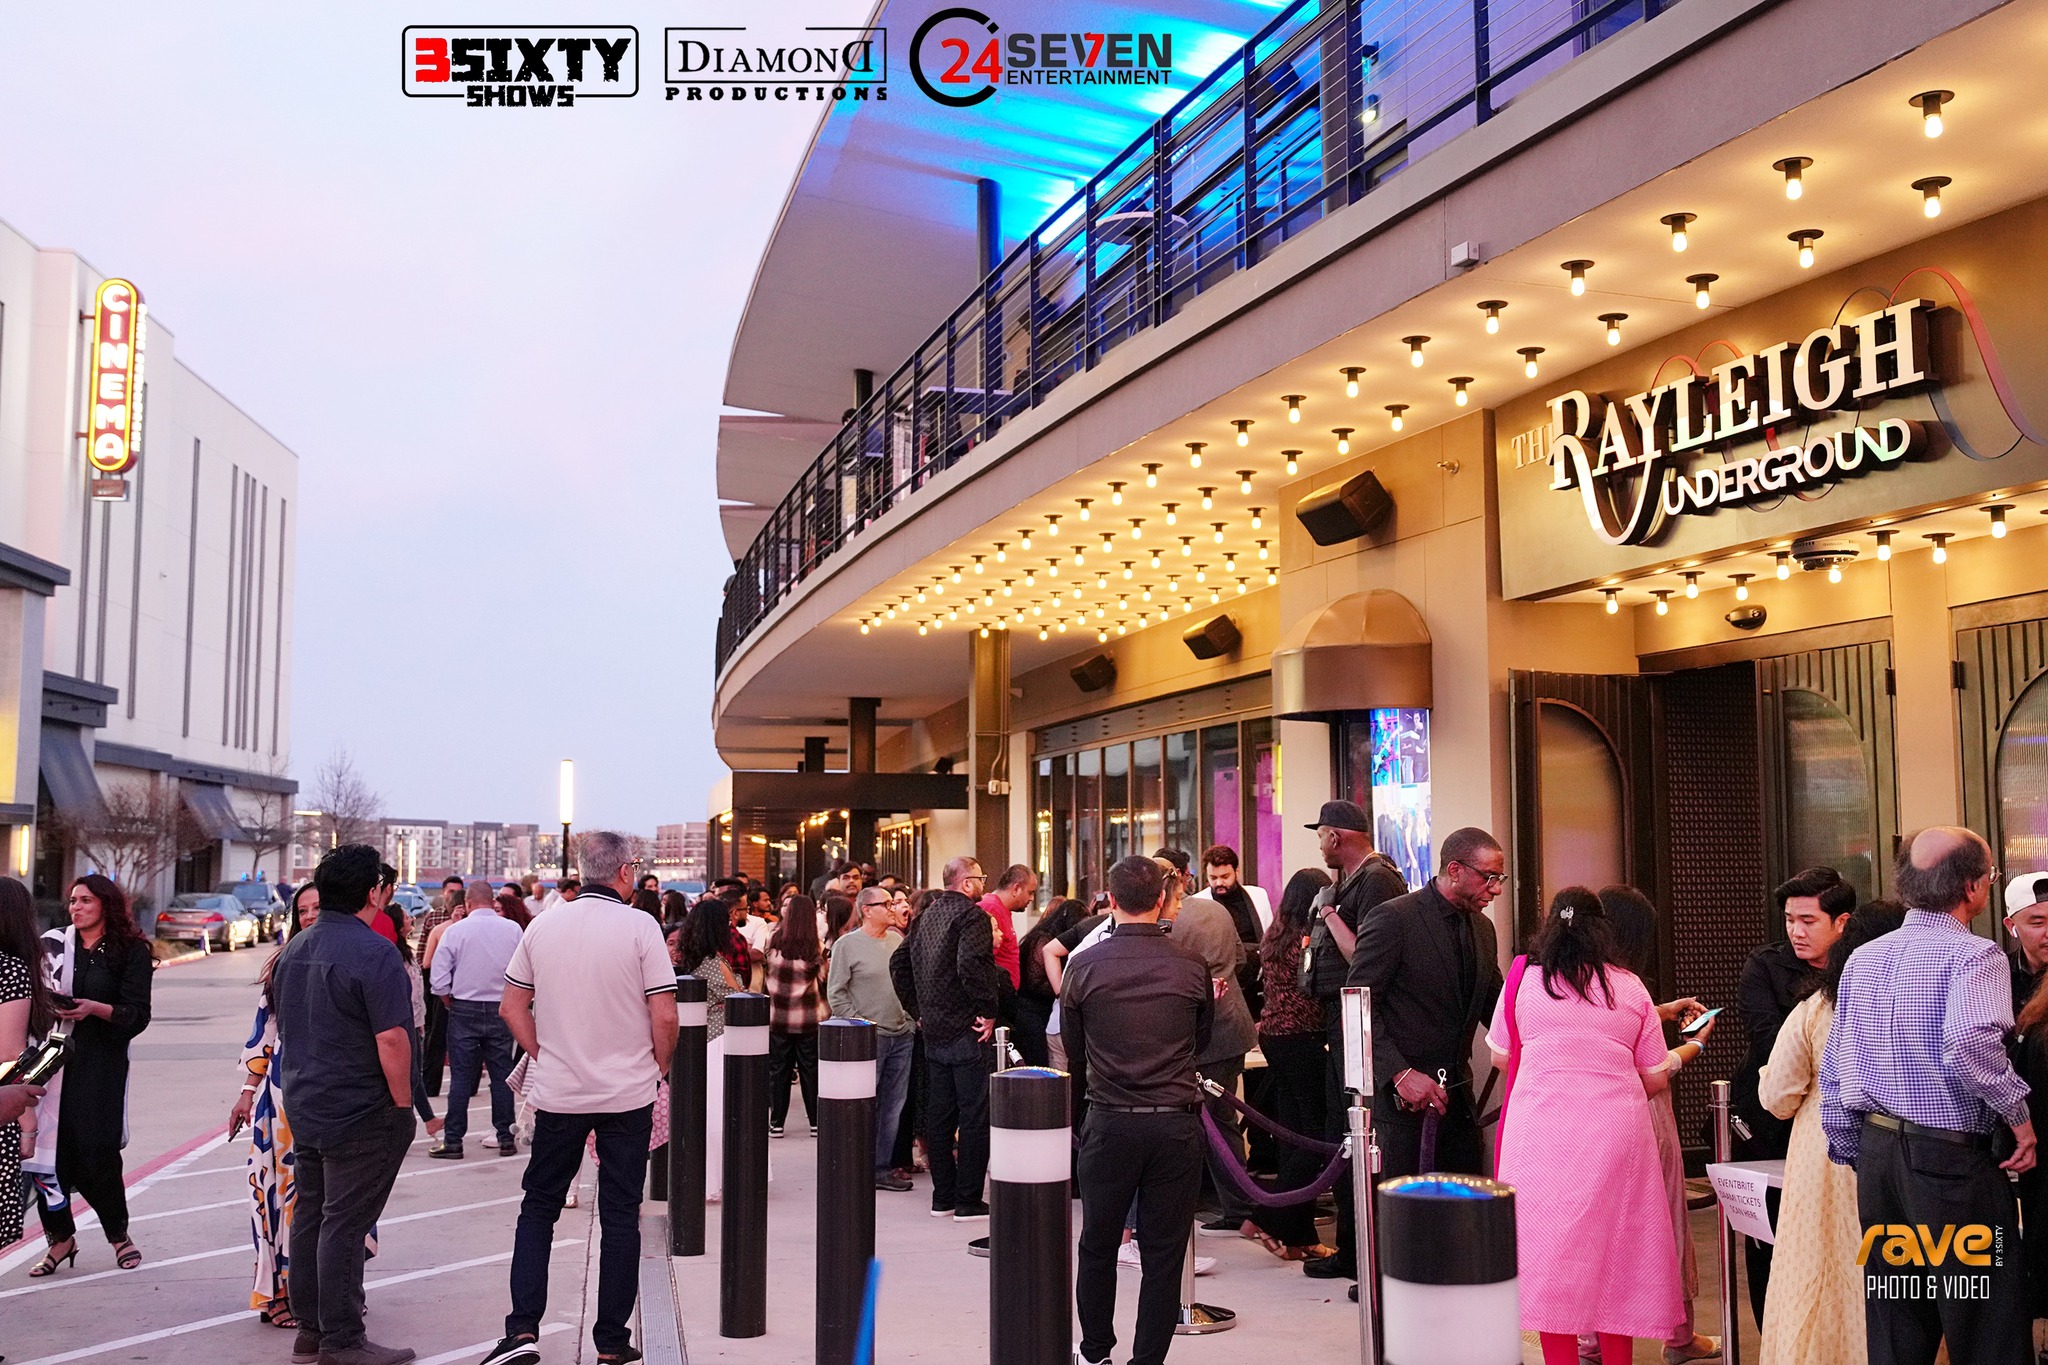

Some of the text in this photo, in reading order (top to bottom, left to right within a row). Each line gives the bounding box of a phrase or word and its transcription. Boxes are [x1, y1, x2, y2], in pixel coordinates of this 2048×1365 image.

[94, 284, 131, 460] CINEMA
[1546, 298, 1925, 545] RAYLEIGH
[1663, 418, 1911, 516] UNDERGROUND
[1717, 1177, 1754, 1192] EVENTBRITE
[1736, 1195, 1762, 1208] TICKETS
